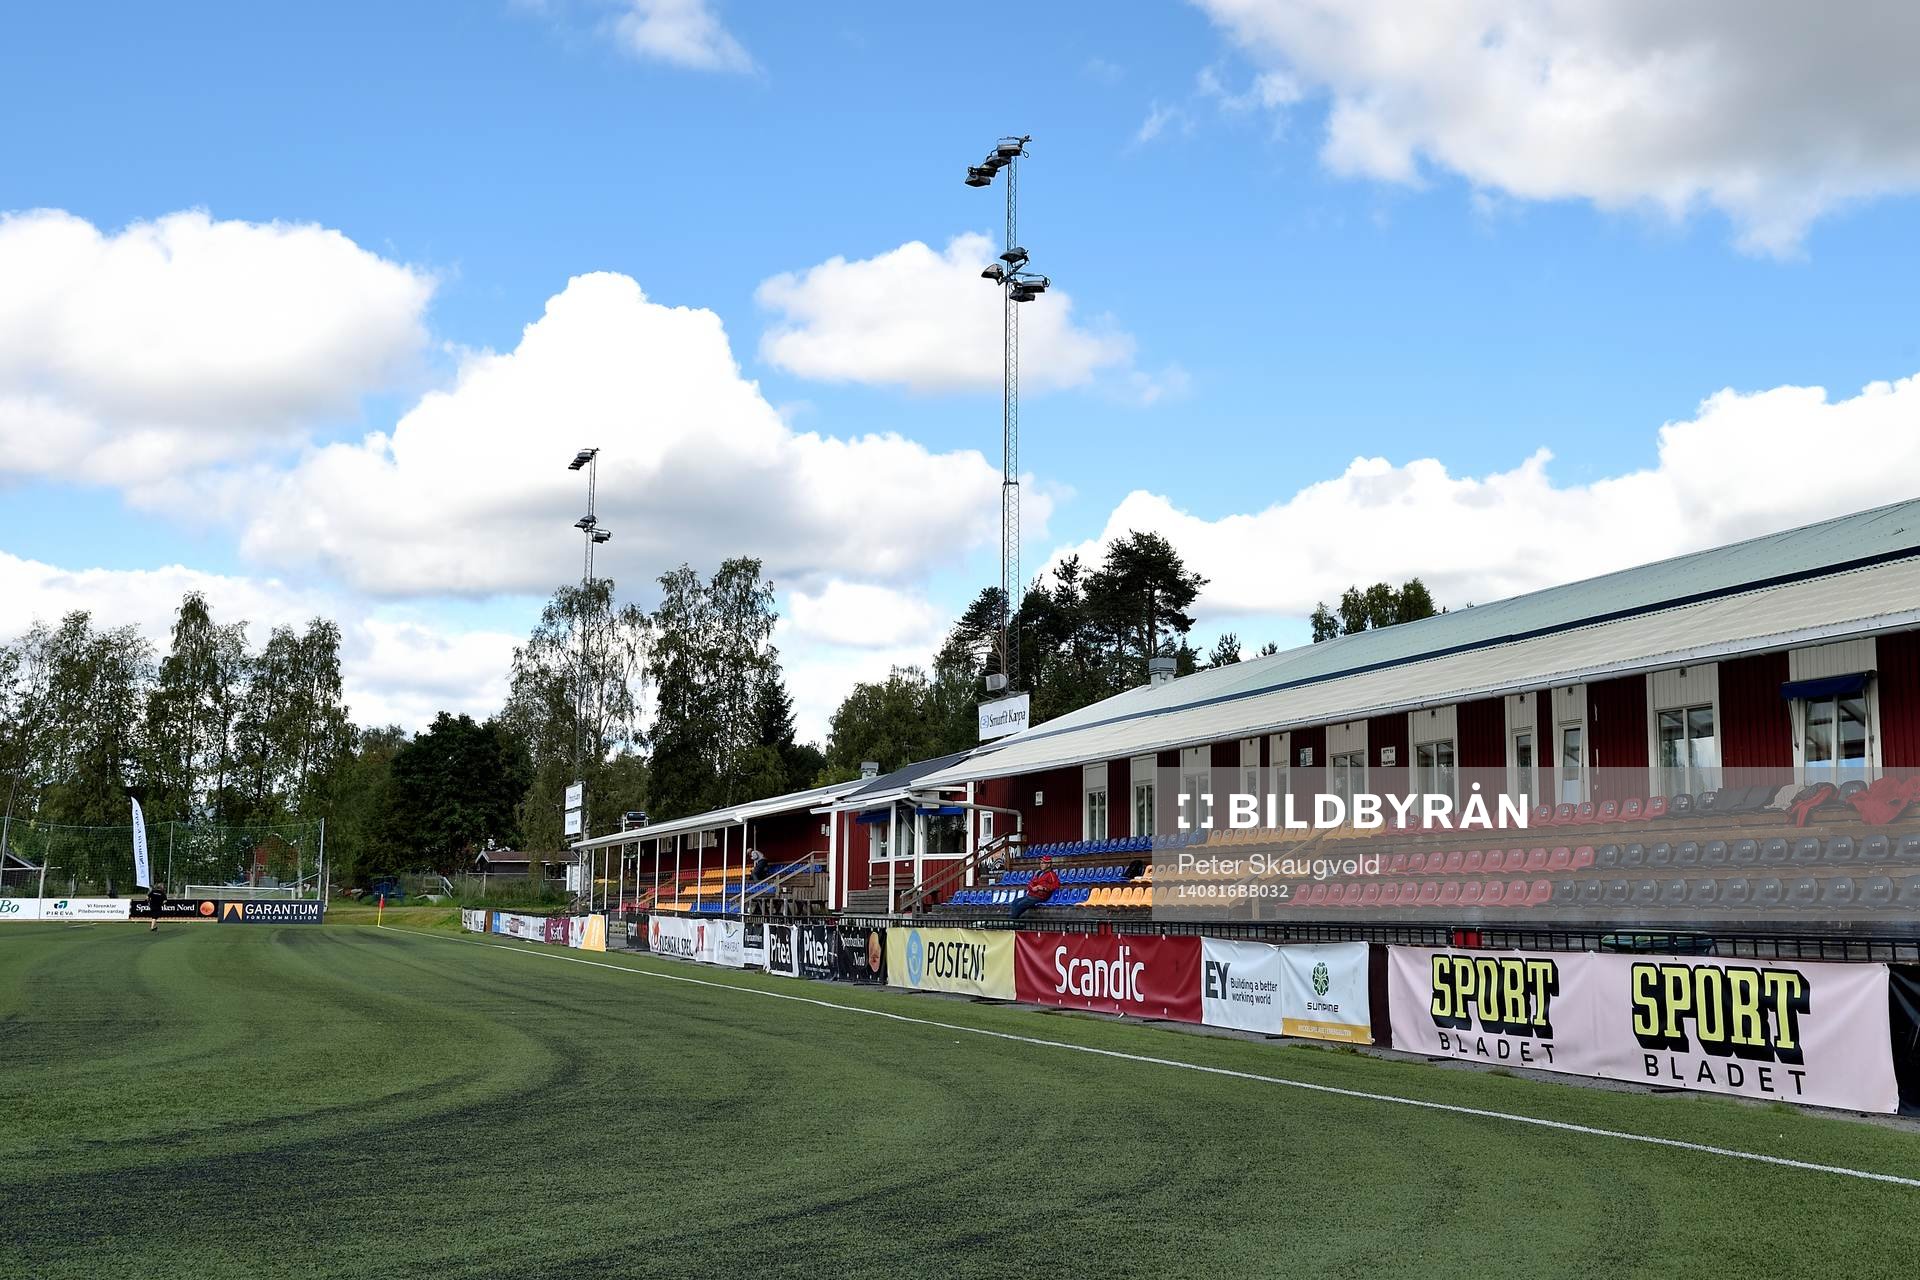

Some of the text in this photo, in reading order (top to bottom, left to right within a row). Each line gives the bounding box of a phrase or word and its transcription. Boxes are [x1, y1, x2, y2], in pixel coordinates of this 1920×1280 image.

[176, 903, 195, 911] Nord
[245, 903, 318, 915] GARANTUM
[770, 933, 791, 965] Piteå
[803, 929, 829, 967] Piteå
[853, 952, 866, 967] Nord
[926, 941, 986, 982] POSTEN!
[1055, 945, 1145, 1002] Scandic
[1205, 960, 1231, 1000] EY
[1230, 978, 1278, 993] Building a better
[1231, 993, 1272, 1006] working world
[1431, 954, 1557, 1033] SPORT
[1631, 962, 1808, 1057] SPORT
[1438, 1031, 1555, 1064] BLADET
[1643, 1053, 1806, 1095] BLADET
